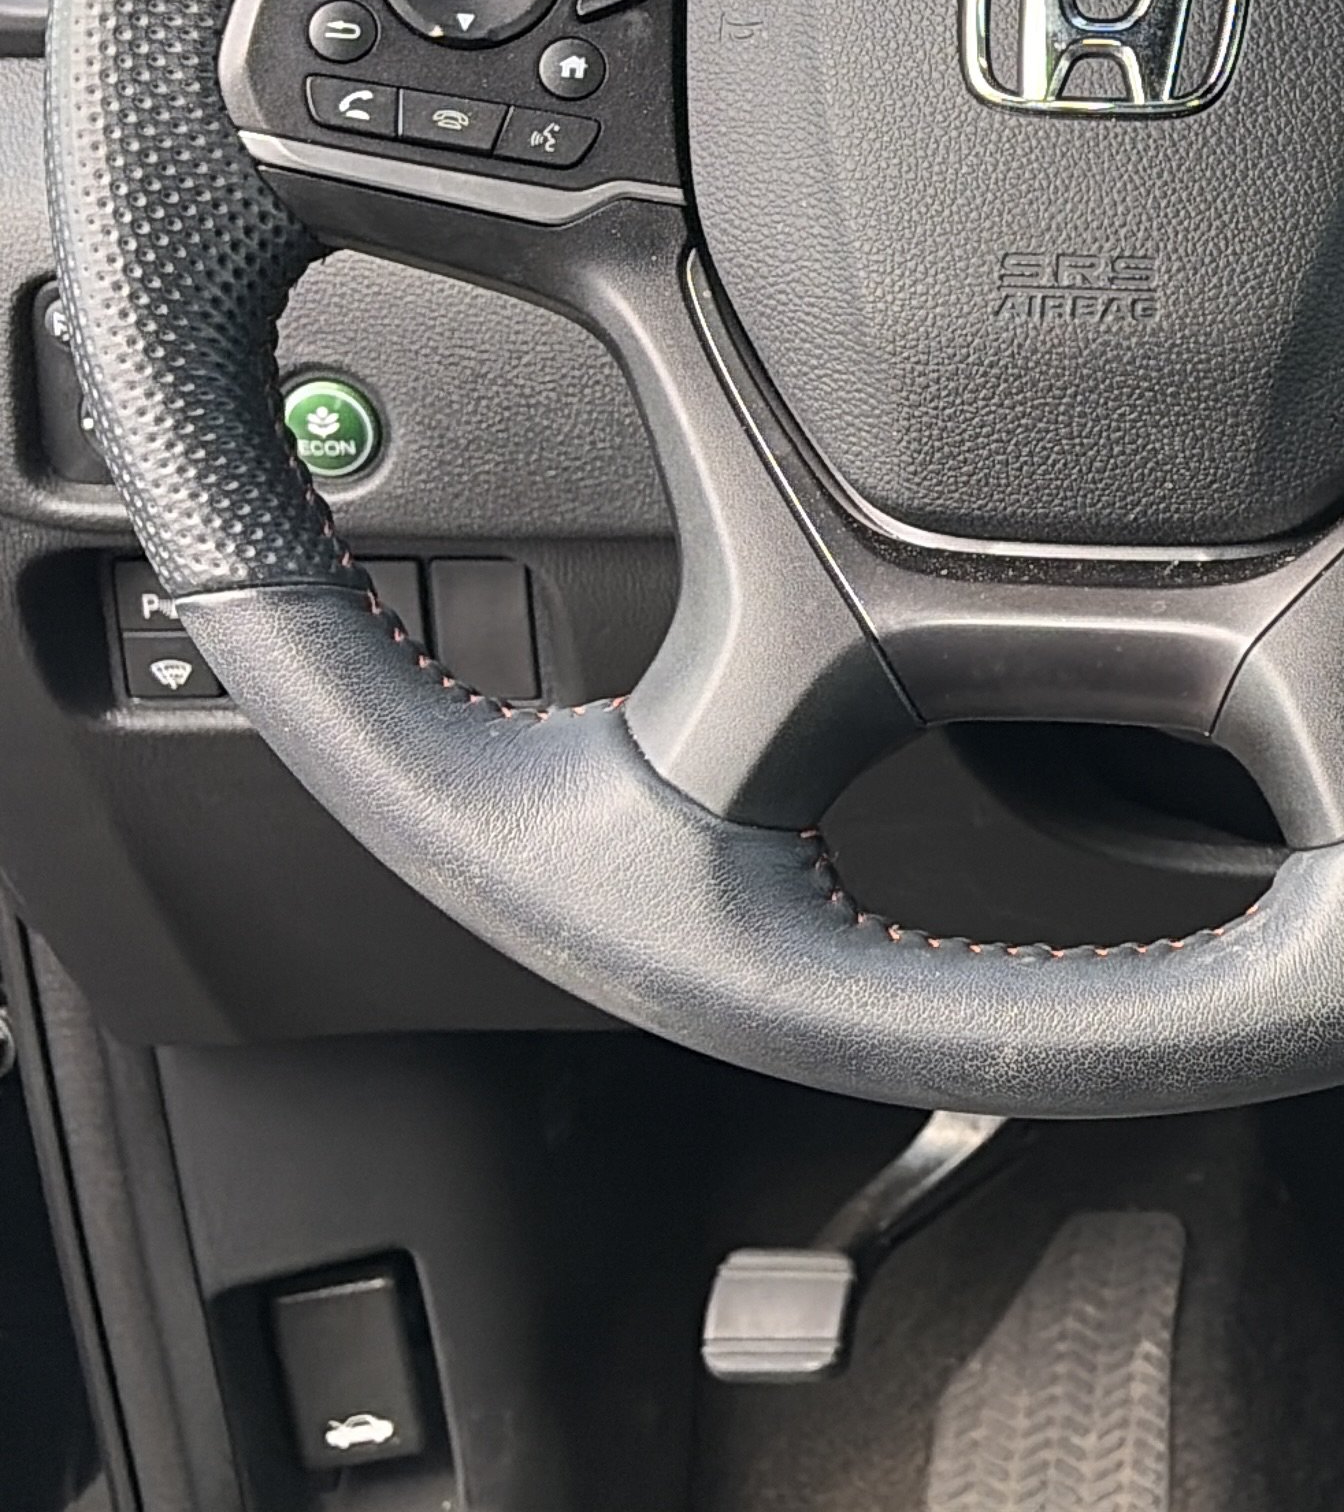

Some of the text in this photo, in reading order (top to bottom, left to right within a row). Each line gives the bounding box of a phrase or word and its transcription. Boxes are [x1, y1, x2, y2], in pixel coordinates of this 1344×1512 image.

[999, 251, 1159, 289] SRS
[993, 293, 1160, 322] AIRBAG
[297, 438, 357, 457] ECON
